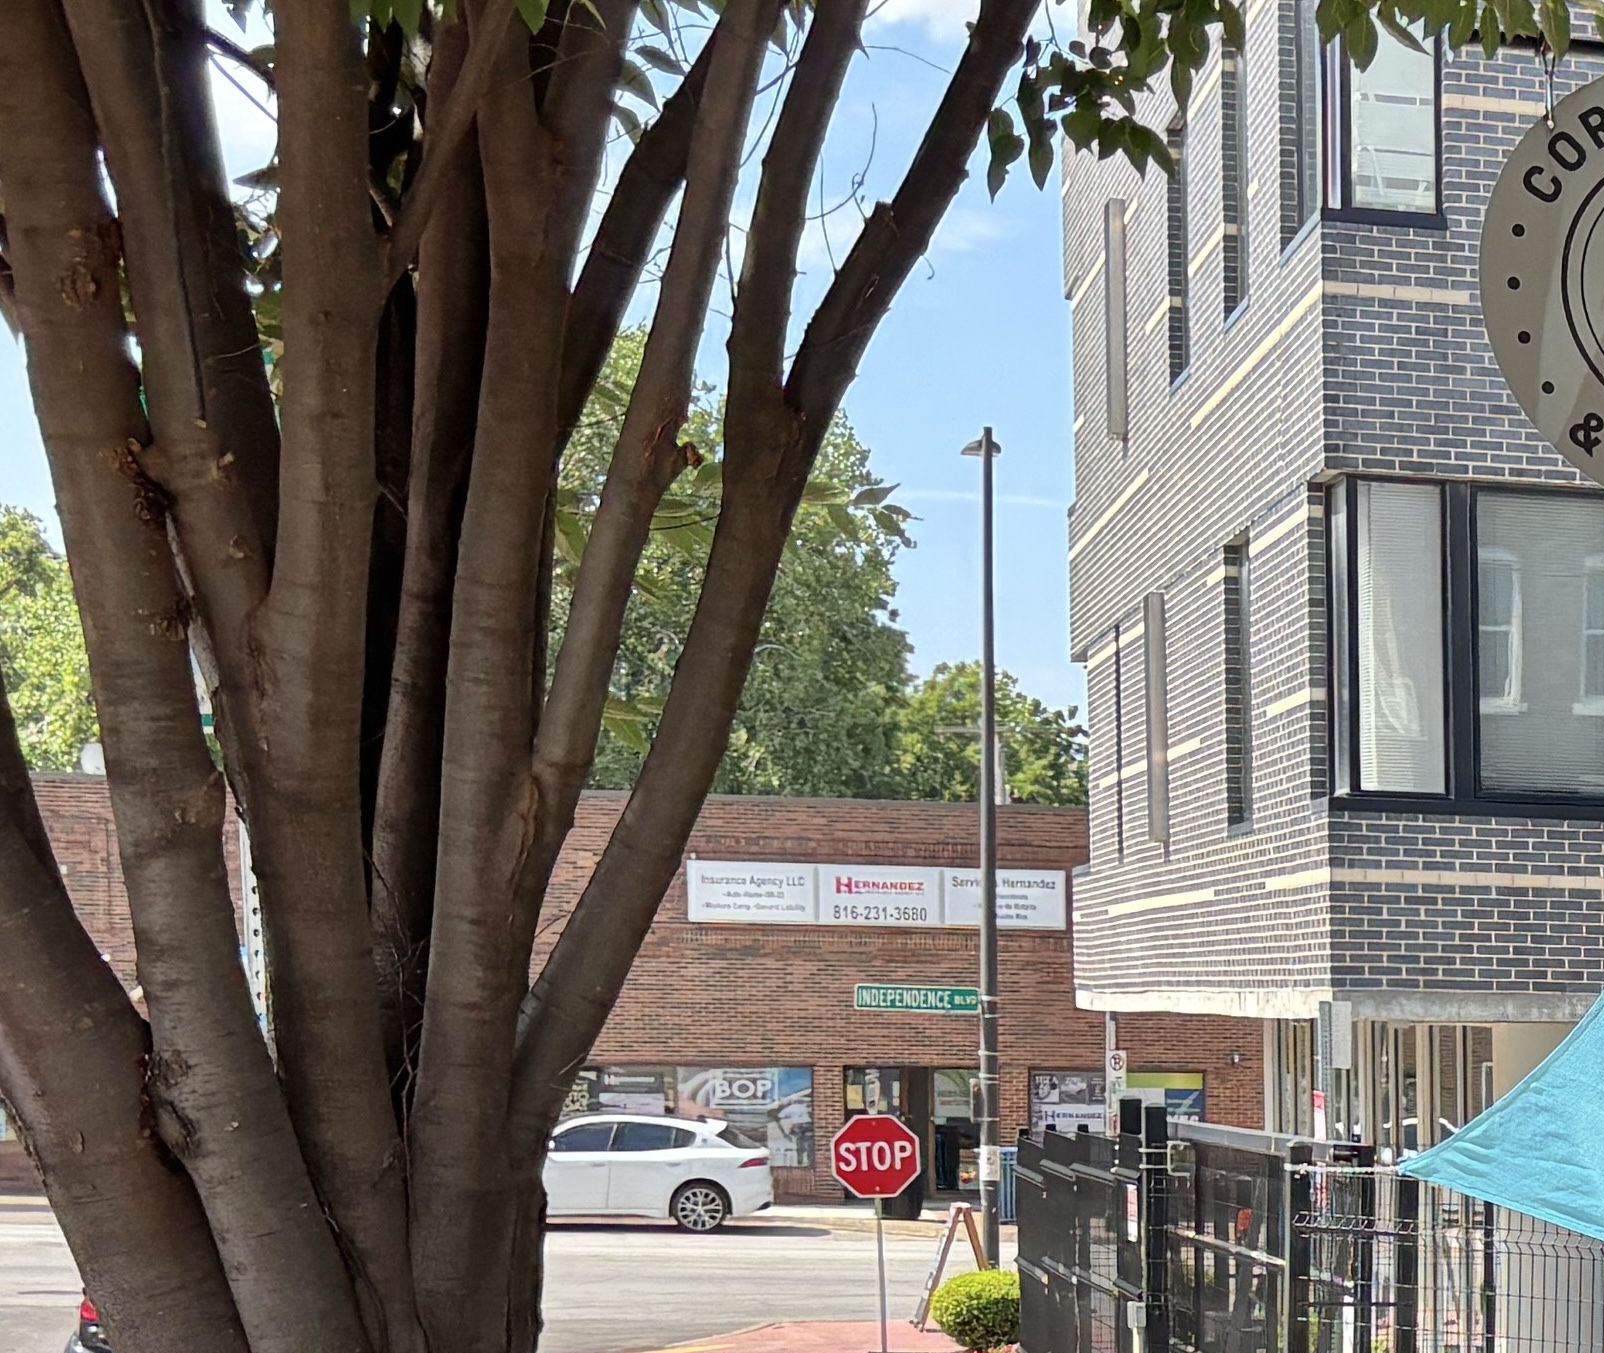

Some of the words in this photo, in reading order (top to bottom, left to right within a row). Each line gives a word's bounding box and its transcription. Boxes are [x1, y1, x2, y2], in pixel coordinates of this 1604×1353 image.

[1568, 411, 1604, 457] &
[701, 875, 747, 885] Insurance
[749, 875, 784, 888] Agency
[786, 876, 805, 887] LLC
[835, 876, 925, 894] HERNANDEZ
[1002, 878, 1056, 890] Hernandez
[833, 904, 927, 922] 816-231-3680
[858, 987, 952, 1008] INDEPENDENCE
[953, 995, 977, 1005] BLVD
[714, 1079, 772, 1099] BOP
[838, 1140, 913, 1172] STOP
